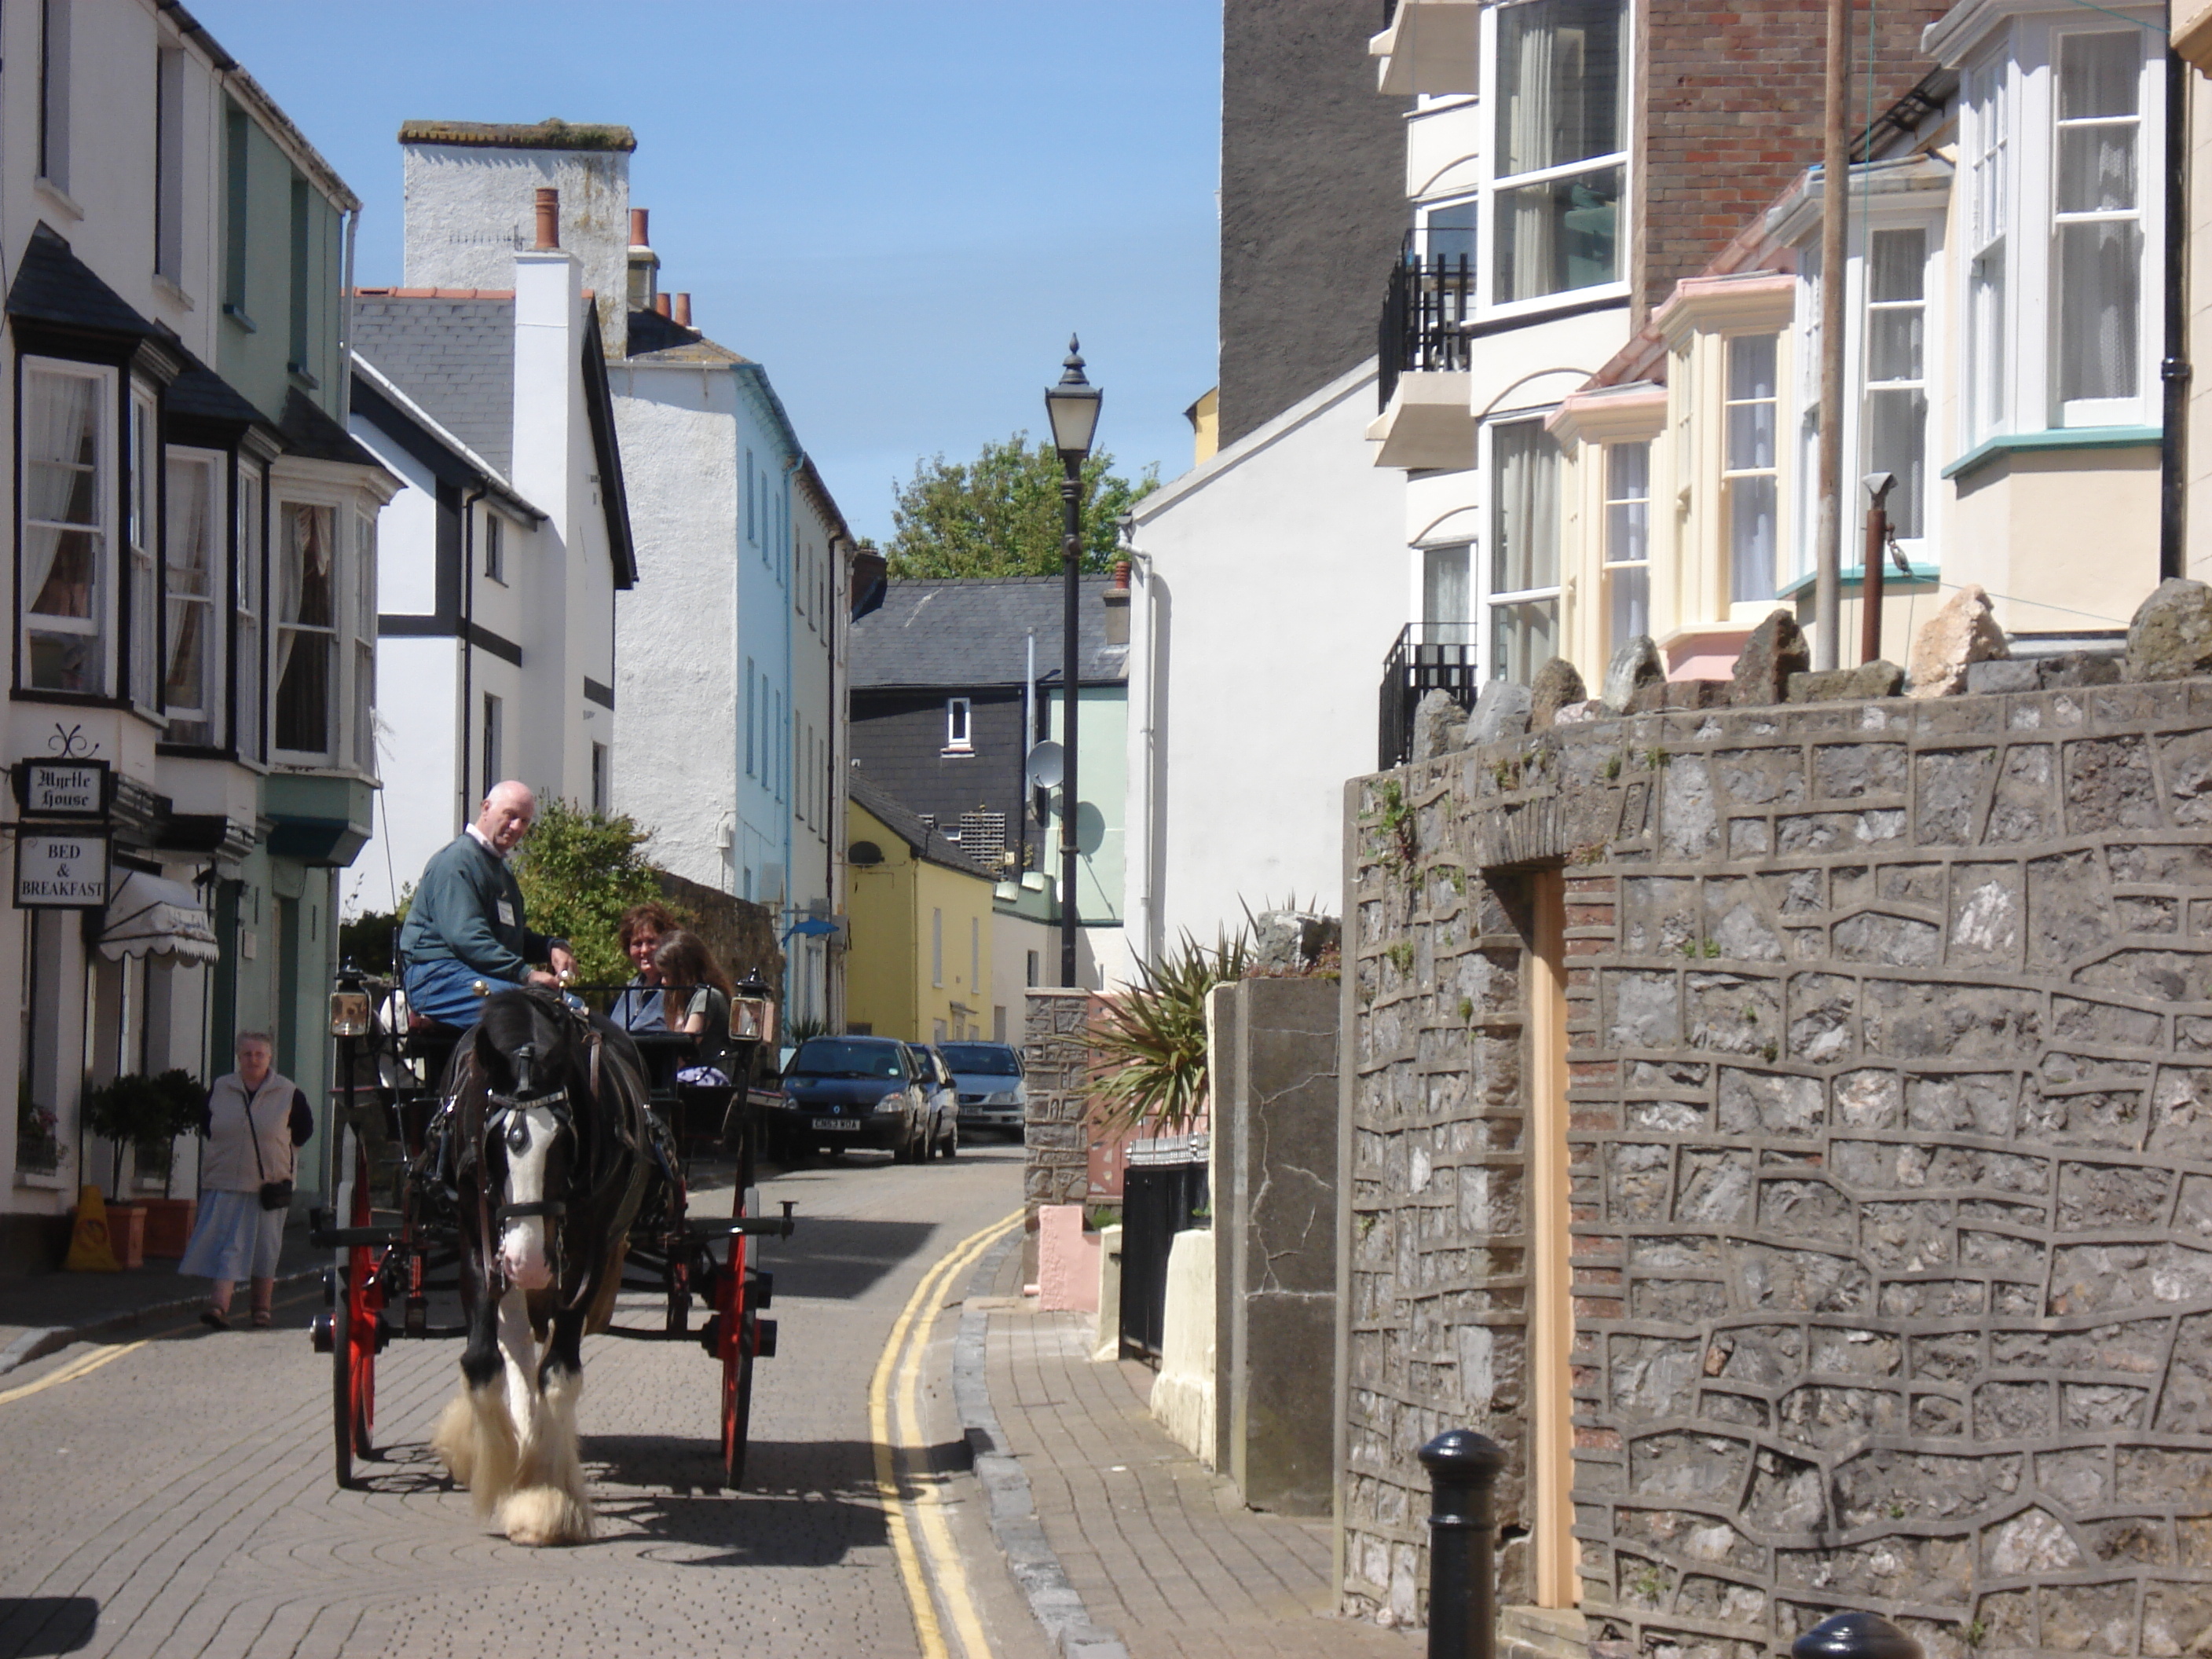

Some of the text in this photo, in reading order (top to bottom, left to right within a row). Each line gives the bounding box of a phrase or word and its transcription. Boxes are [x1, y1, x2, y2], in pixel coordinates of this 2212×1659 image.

[38, 769, 90, 789] Myrtle
[42, 789, 90, 808] House
[49, 844, 81, 859] BED
[57, 862, 70, 877] &
[22, 881, 104, 896] BREAKFAST
